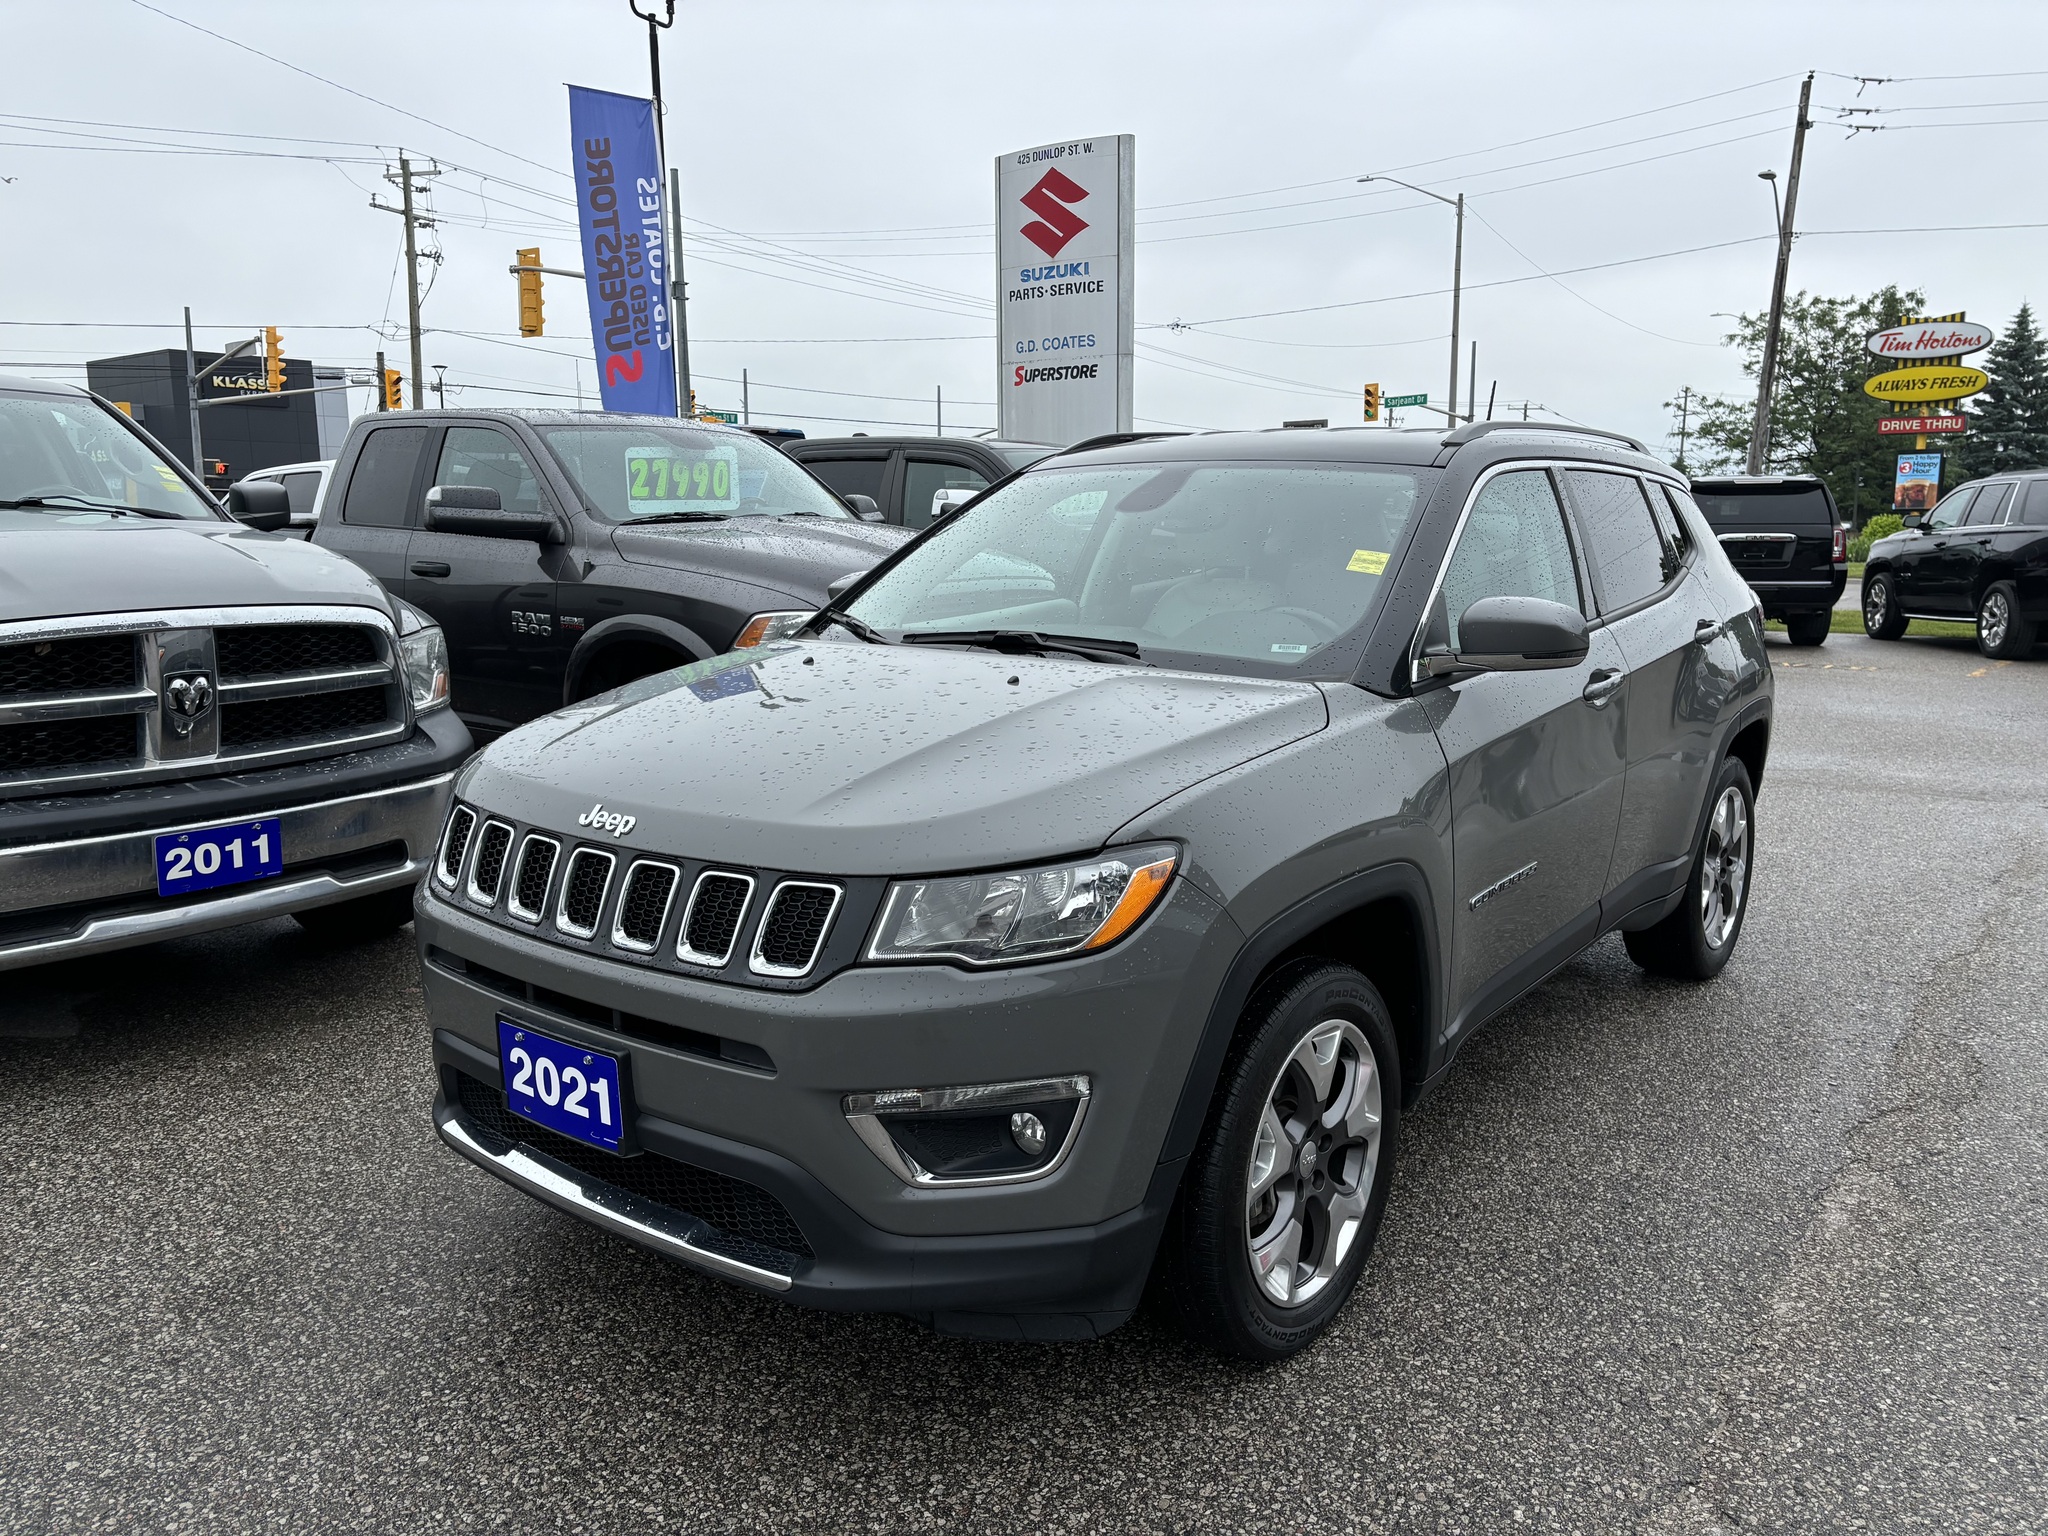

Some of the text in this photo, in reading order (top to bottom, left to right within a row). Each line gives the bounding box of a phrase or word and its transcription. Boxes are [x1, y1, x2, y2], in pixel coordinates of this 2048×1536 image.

[1017, 142, 1095, 165] 425 DUNLOP ST. W.
[1020, 262, 1090, 283] SUZUKI
[1016, 334, 1096, 354] G.D. COATES
[1879, 330, 1982, 353] Tim Hortons
[1014, 363, 1099, 387] SUPERSTORE
[1872, 376, 1980, 393] ALWAYS FRESH
[1387, 397, 1415, 406] Sarjeant
[1881, 418, 1962, 431] DRIVE THRU
[1912, 461, 1939, 469] Happy
[511, 610, 551, 626] RAM
[511, 621, 552, 637] 1500
[578, 803, 637, 839] Jeep
[165, 833, 270, 881] 2011
[509, 1046, 612, 1126] 2021
